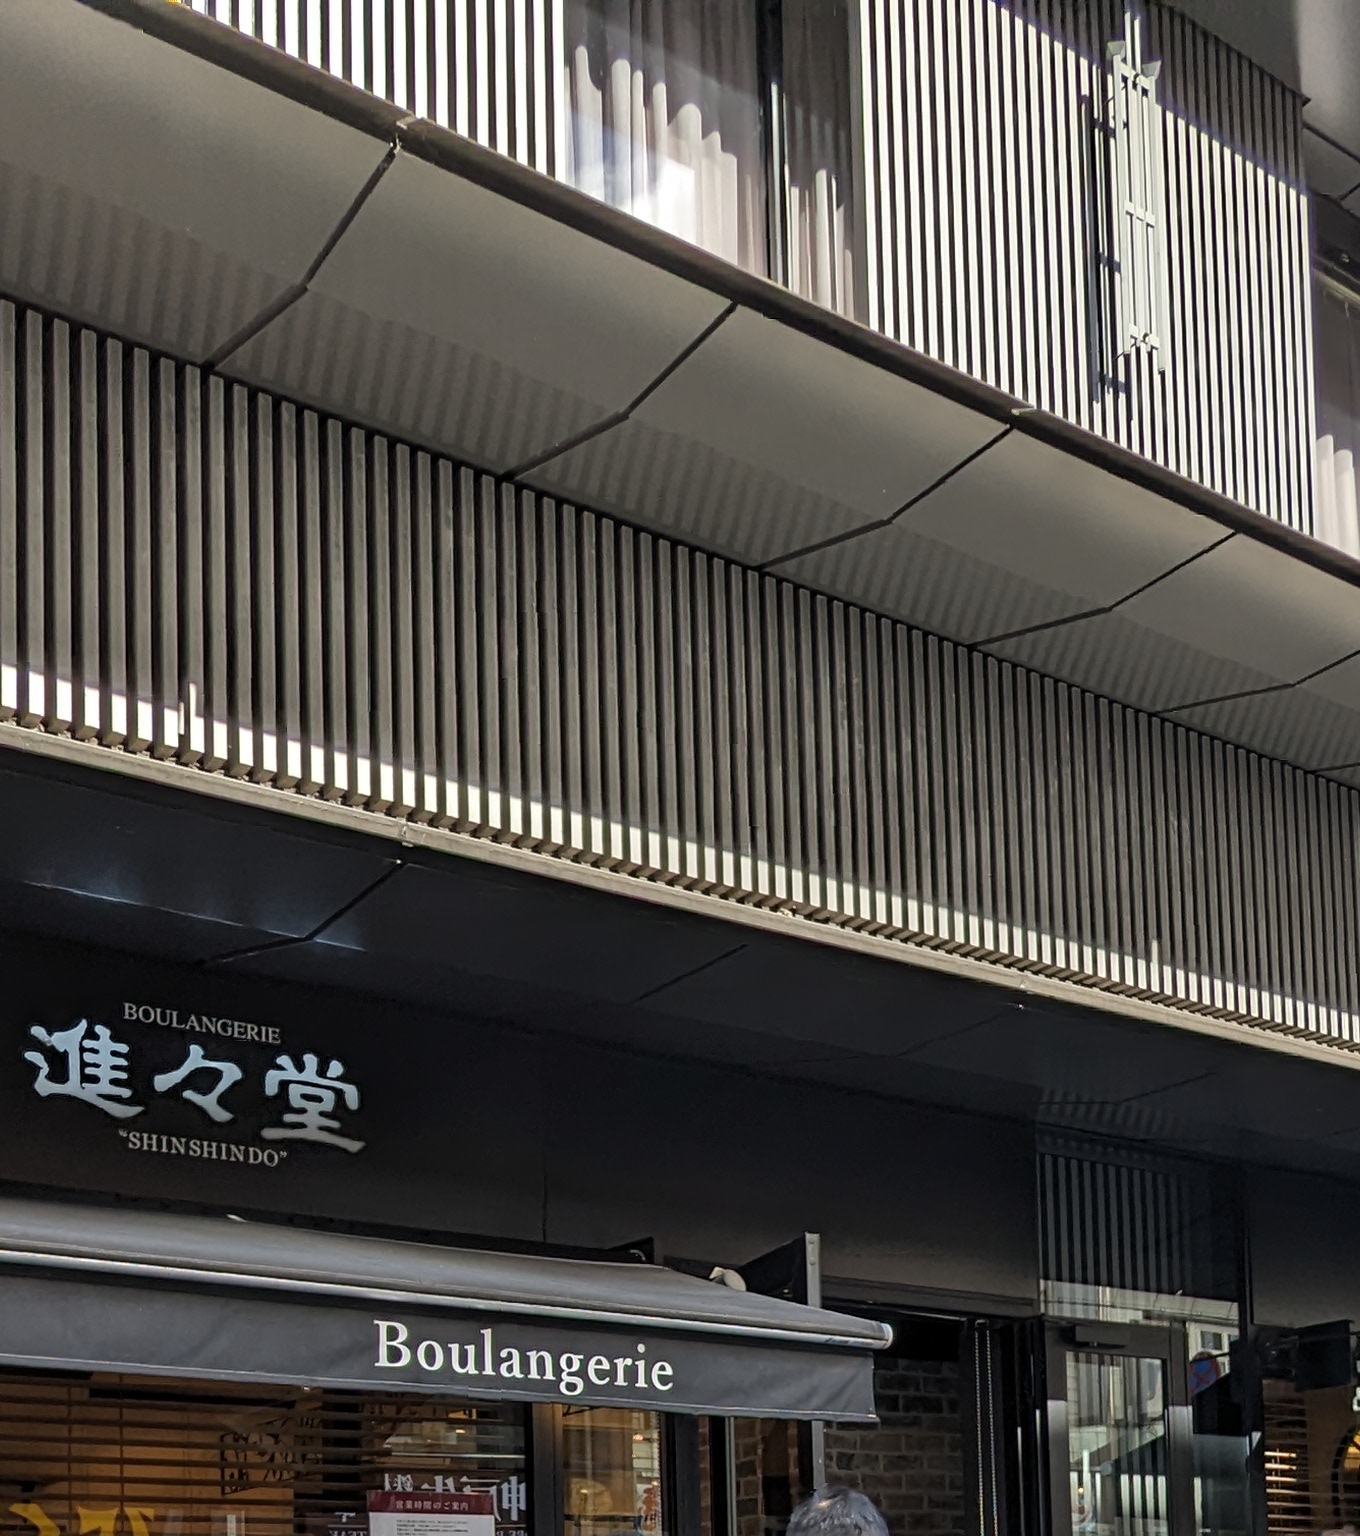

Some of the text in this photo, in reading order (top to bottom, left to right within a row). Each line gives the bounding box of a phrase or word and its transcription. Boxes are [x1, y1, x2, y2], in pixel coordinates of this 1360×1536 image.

[122, 1002, 281, 1044] BOULANGERIE
[24, 1018, 366, 1153] 進々堂
[373, 1319, 674, 1396] Boulangerie
[395, 1500, 469, 1511] 営業時間のご案内
